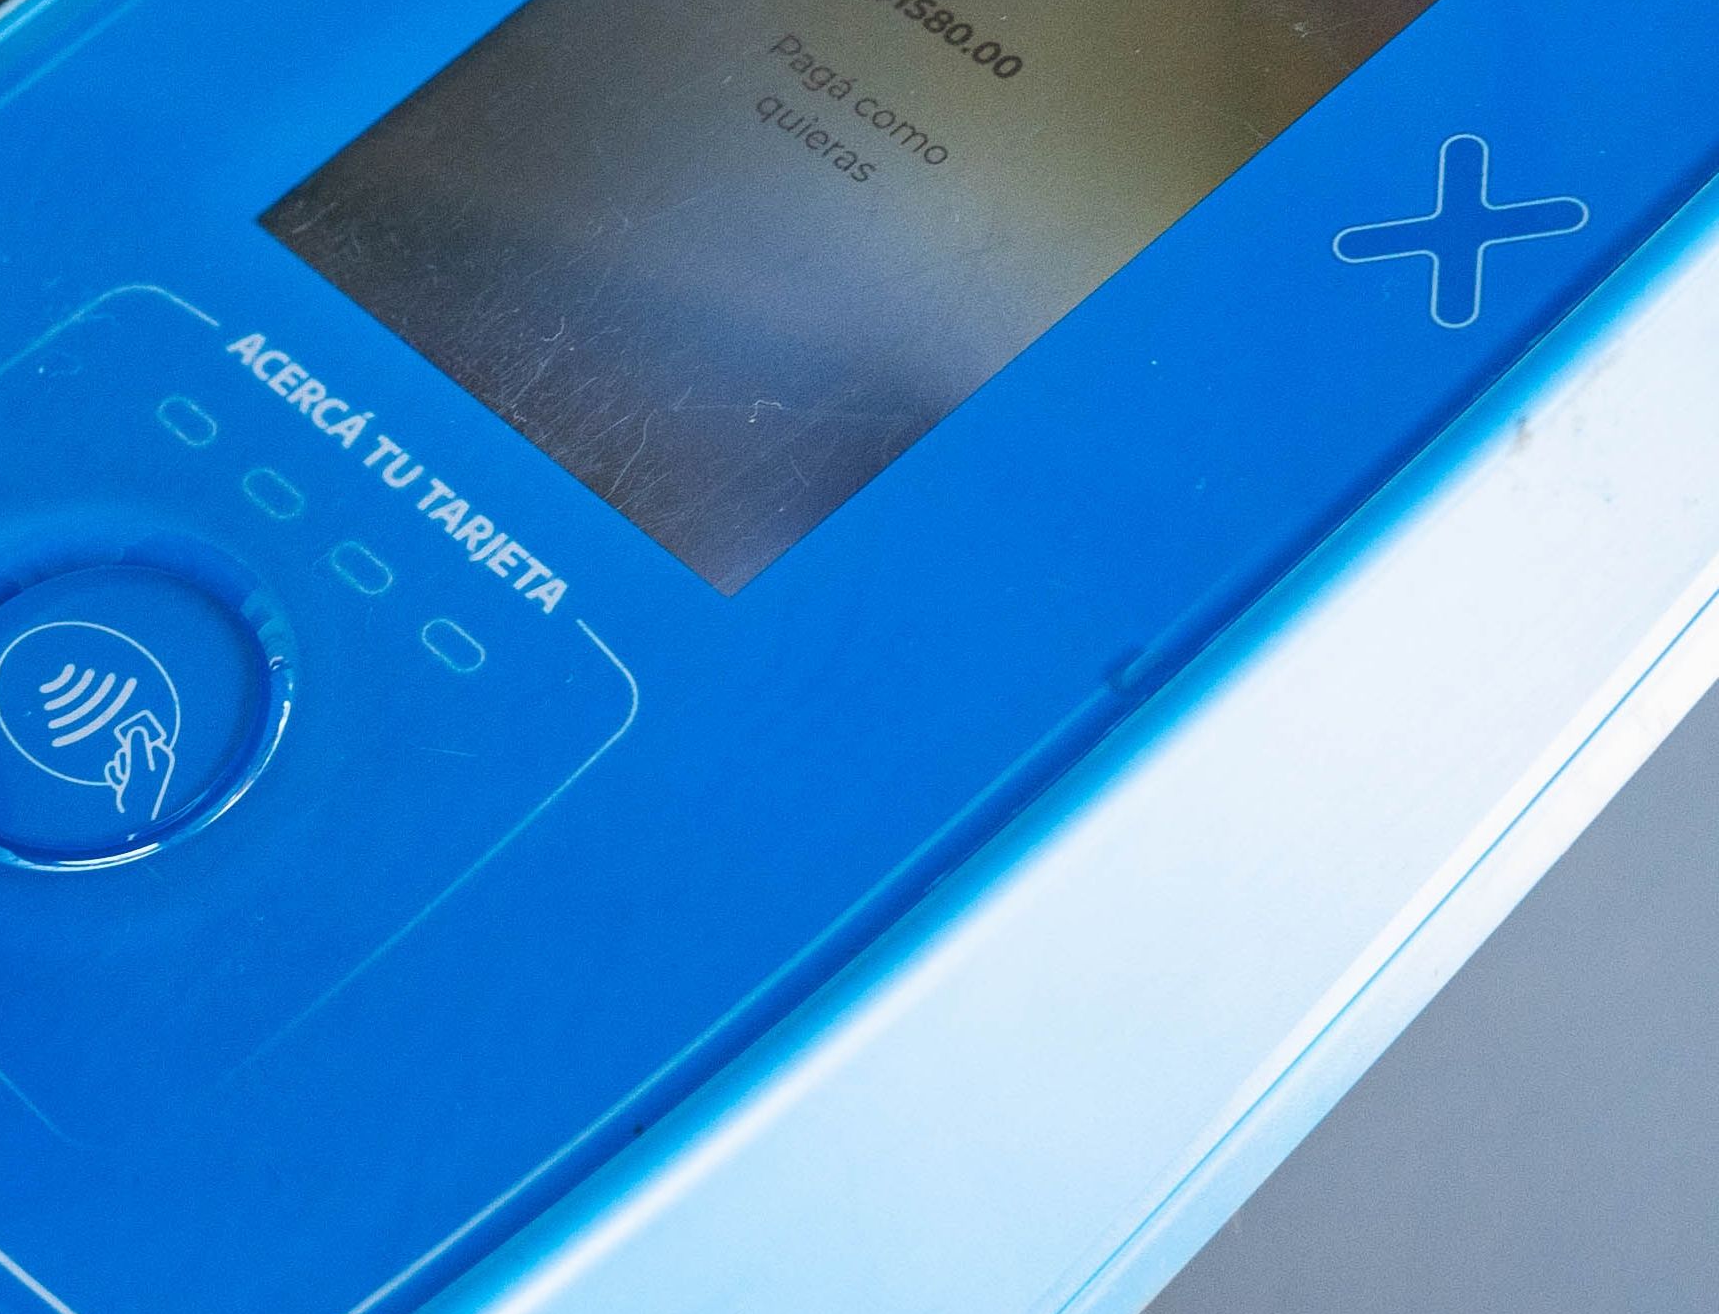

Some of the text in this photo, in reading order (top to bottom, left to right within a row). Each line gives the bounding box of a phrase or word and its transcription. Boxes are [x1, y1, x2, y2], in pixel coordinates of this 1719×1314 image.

[756, 96, 876, 183] quieras
[770, 35, 948, 165] Pagá como
[226, 333, 569, 614] ACERCÁ TU TARJETA
